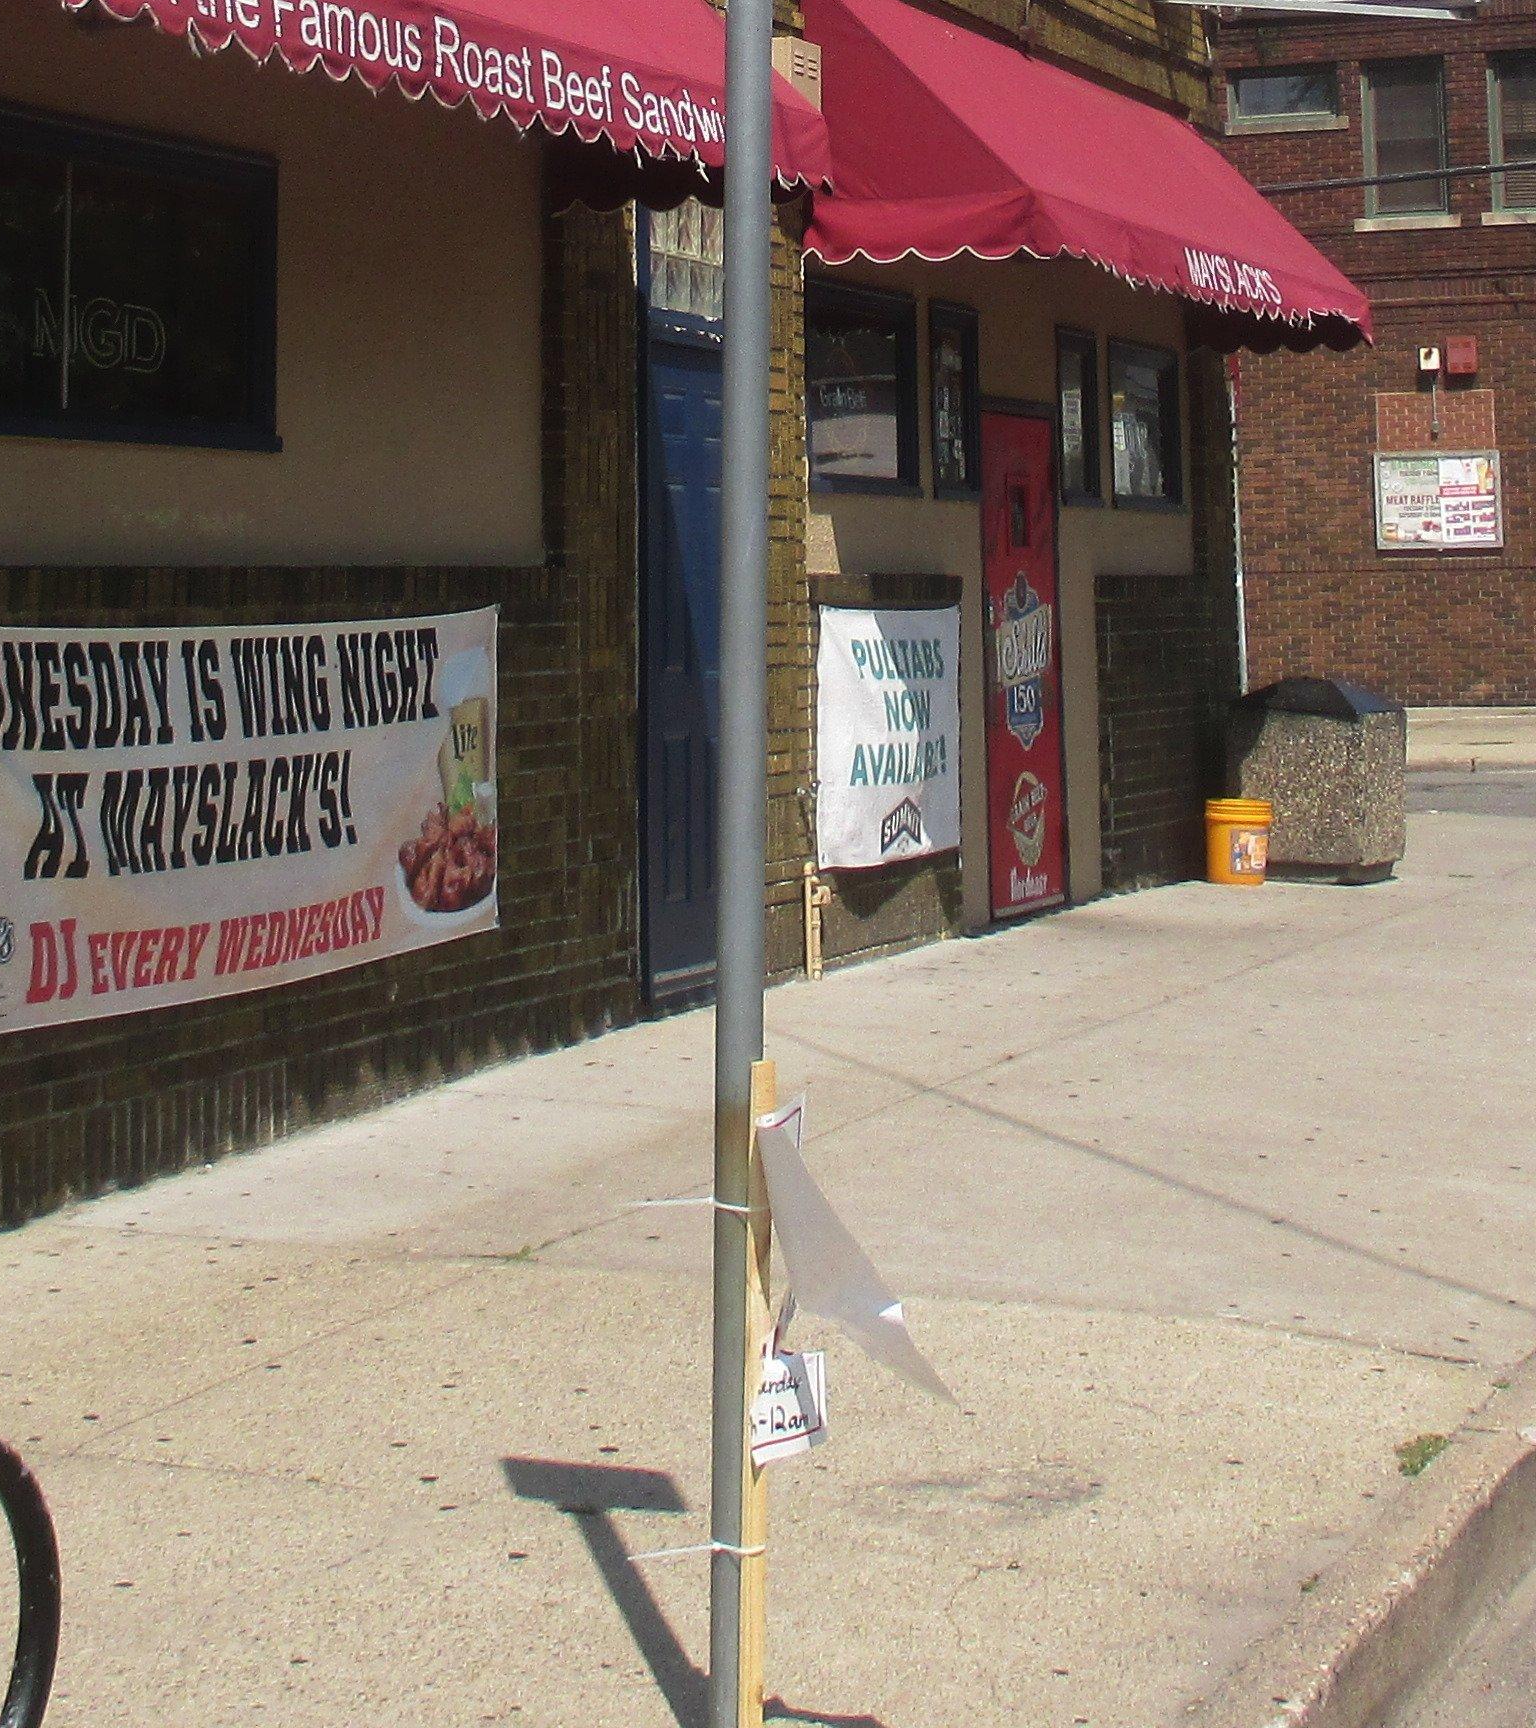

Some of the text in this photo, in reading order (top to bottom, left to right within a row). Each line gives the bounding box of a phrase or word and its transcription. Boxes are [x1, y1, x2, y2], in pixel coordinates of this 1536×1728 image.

[434, 15, 535, 103] Roast
[541, 50, 613, 123] Beef
[621, 72, 727, 145] Sandwi
[181, 639, 227, 742] IS
[230, 634, 331, 739] WING
[336, 627, 440, 730] NIGHT
[883, 689, 931, 732] NOW
[1013, 683, 1036, 713] 150
[23, 749, 358, 880] AT MAYSLACK'S!
[25, 885, 386, 1004] DJ EVERY WEDNESDAY
